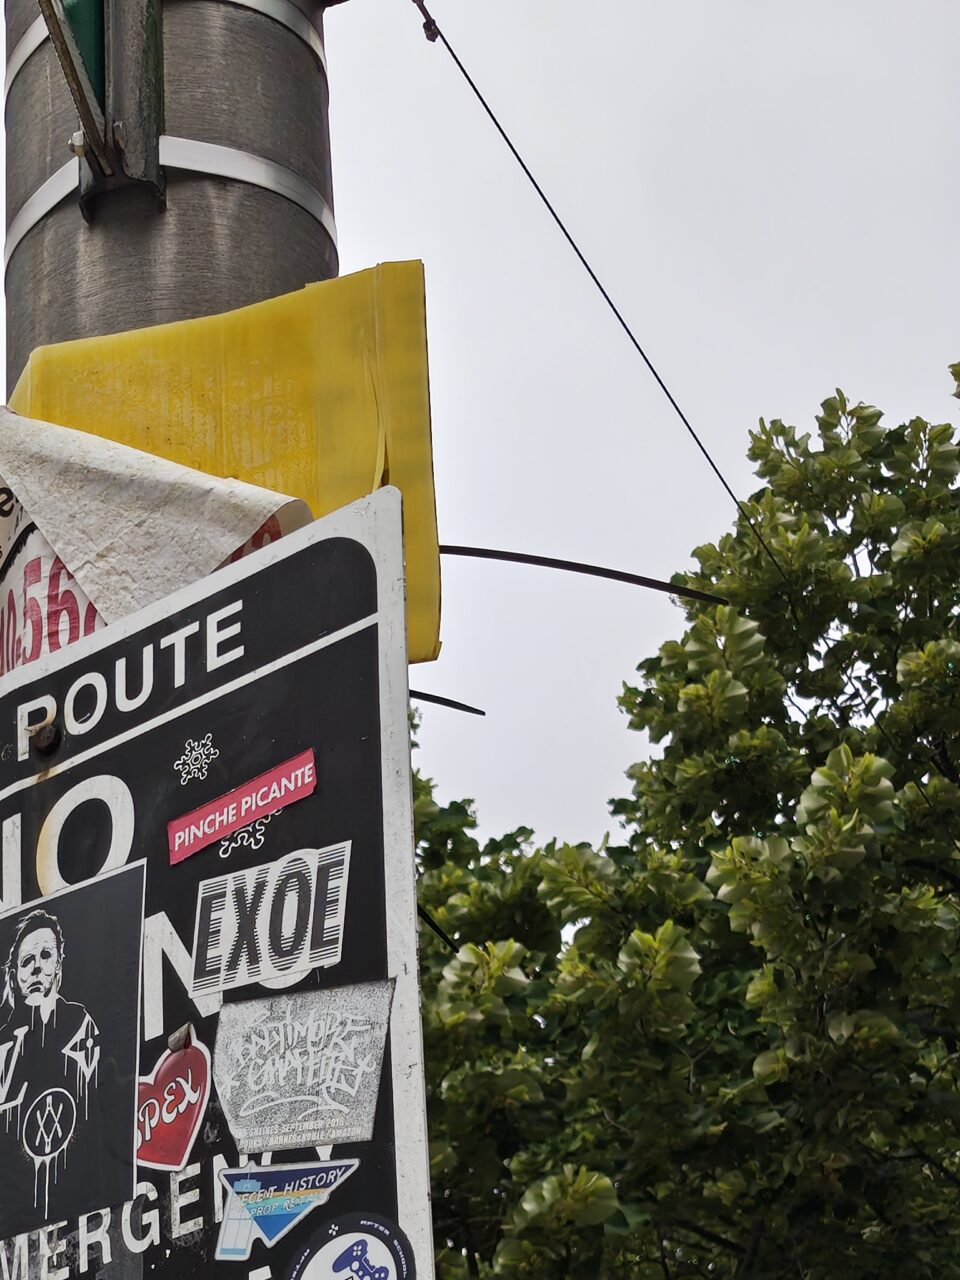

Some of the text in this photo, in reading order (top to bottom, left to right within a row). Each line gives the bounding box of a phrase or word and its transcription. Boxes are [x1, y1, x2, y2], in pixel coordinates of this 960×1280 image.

[174, 763, 315, 851] PINCHE PICANTE
[137, 1068, 200, 1150] PEX
[284, 1167, 345, 1196] HISTORY
[250, 1203, 278, 1217] PROP
[393, 1239, 407, 1279] SCHOOL
